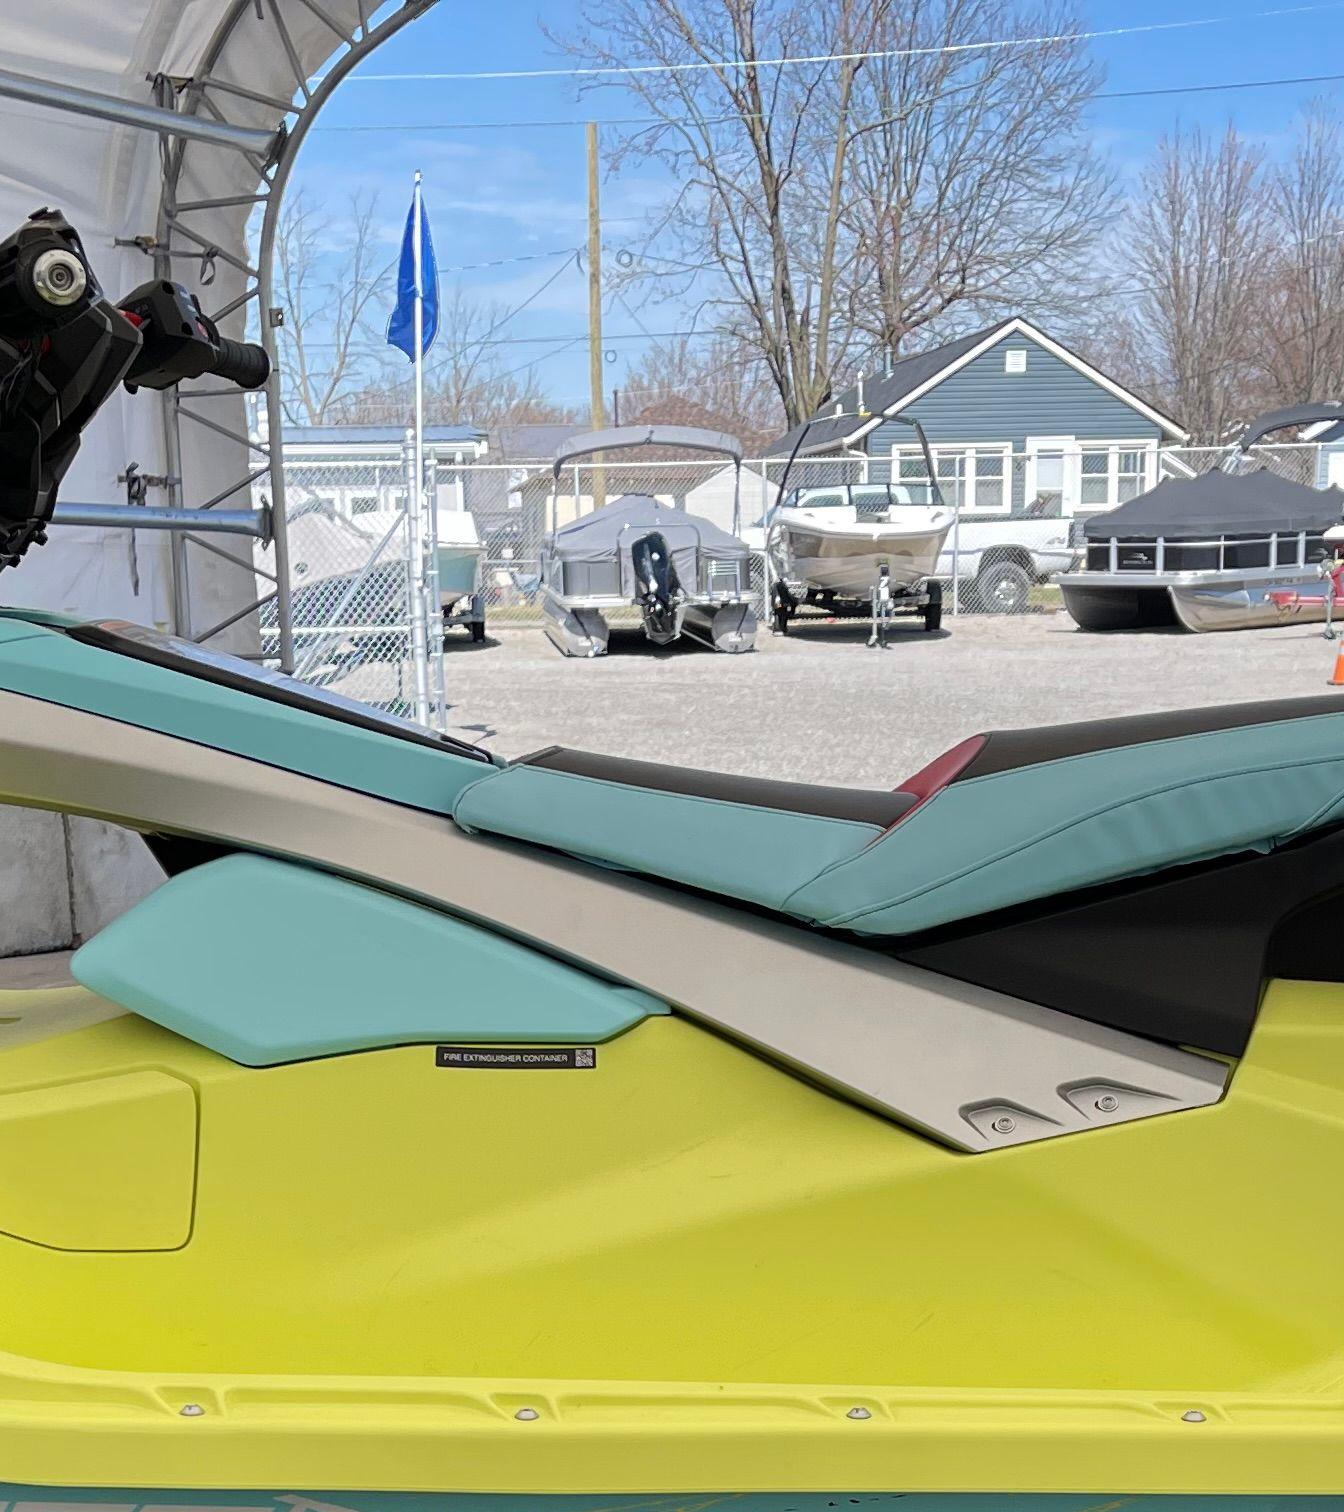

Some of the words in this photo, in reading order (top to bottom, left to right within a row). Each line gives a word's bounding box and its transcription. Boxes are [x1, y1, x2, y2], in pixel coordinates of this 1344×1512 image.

[443, 1053, 462, 1062] FIRE
[463, 1053, 522, 1063] EXTINGUISHER
[523, 1053, 568, 1063] CONTAINER
